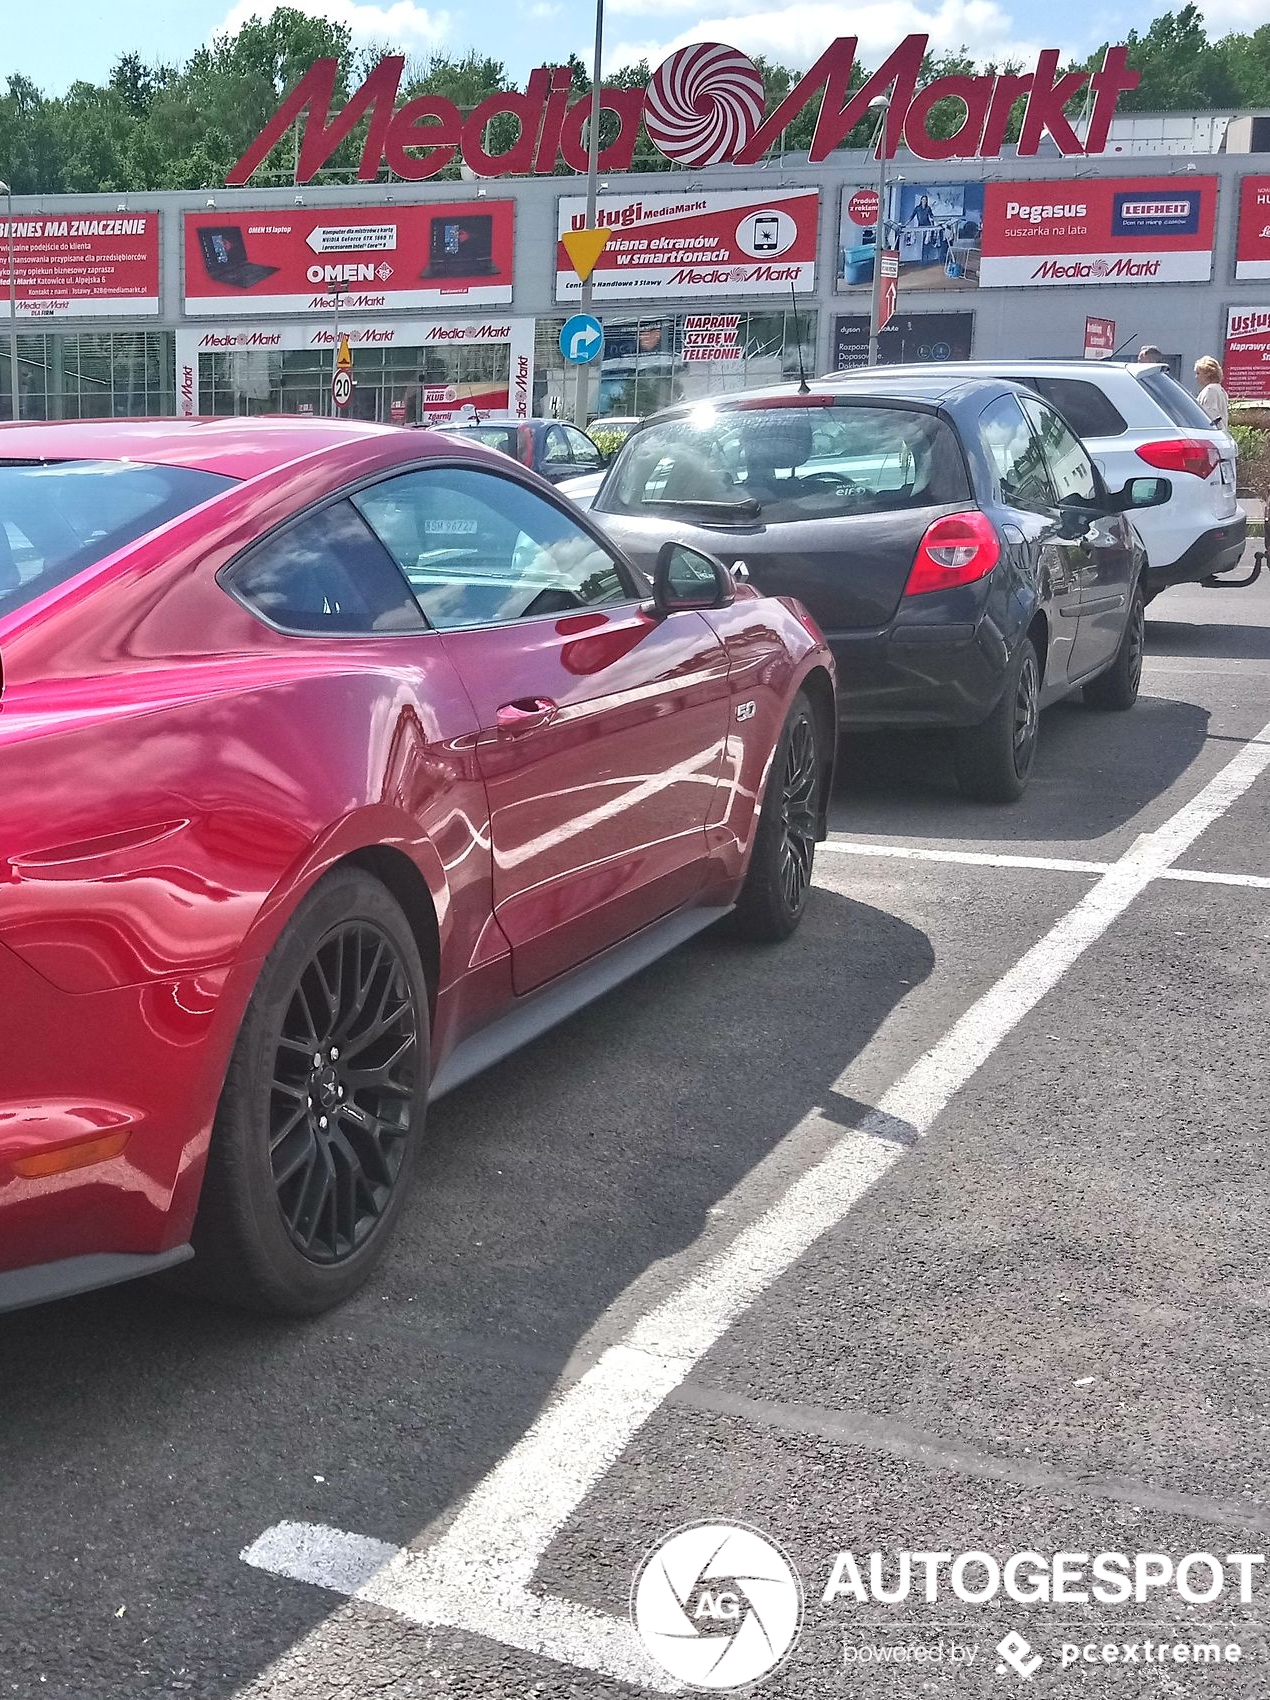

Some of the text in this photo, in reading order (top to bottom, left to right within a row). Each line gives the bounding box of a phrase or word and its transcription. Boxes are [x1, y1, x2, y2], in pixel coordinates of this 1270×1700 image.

[225, 34, 1140, 185] Media Markt
[571, 200, 707, 231] Uługi MediaMarkt
[1006, 202, 1087, 223] Pegasus
[1125, 203, 1188, 215] LEIFHEIT
[45, 221, 68, 237] MA
[70, 219, 146, 236] ZNACZENIE
[248, 226, 291, 235] OMEN 15 laptop
[1005, 226, 1087, 238] suszarka na lata
[70, 242, 91, 250] klienta
[649, 236, 719, 250] ekranów
[50, 255, 84, 264] przypisane
[616, 249, 729, 265] w smartfonach
[27, 267, 53, 276] opiekun
[54, 267, 86, 275] biznesowy
[87, 266, 114, 274] zaprasza
[306, 264, 375, 283] OMEN
[1031, 258, 1161, 279] Media Markt
[17, 277, 36, 285] Markt
[37, 277, 65, 285] Katowice
[74, 276, 100, 285] Alpejska
[666, 266, 802, 285] Media Markt
[597, 280, 633, 288] Handlowe
[639, 279, 661, 288] Stawy
[28, 288, 49, 296] Kontakt
[16, 300, 69, 309] Media Markt
[353, 295, 385, 307] Markt
[686, 315, 740, 328] NAPRAW
[1231, 313, 1270, 331] Usłu
[359, 329, 394, 342] Markt
[425, 325, 512, 340] Media Markt
[840, 326, 860, 334] dyson
[198, 332, 281, 346] Media Markt
[686, 331, 736, 346] SZYBĘ W
[1230, 343, 1266, 352] Naprawy
[682, 349, 743, 361] TELEFONIE
[515, 354, 528, 392] Markt
[181, 365, 192, 401] Markt
[335, 379, 350, 397] 20
